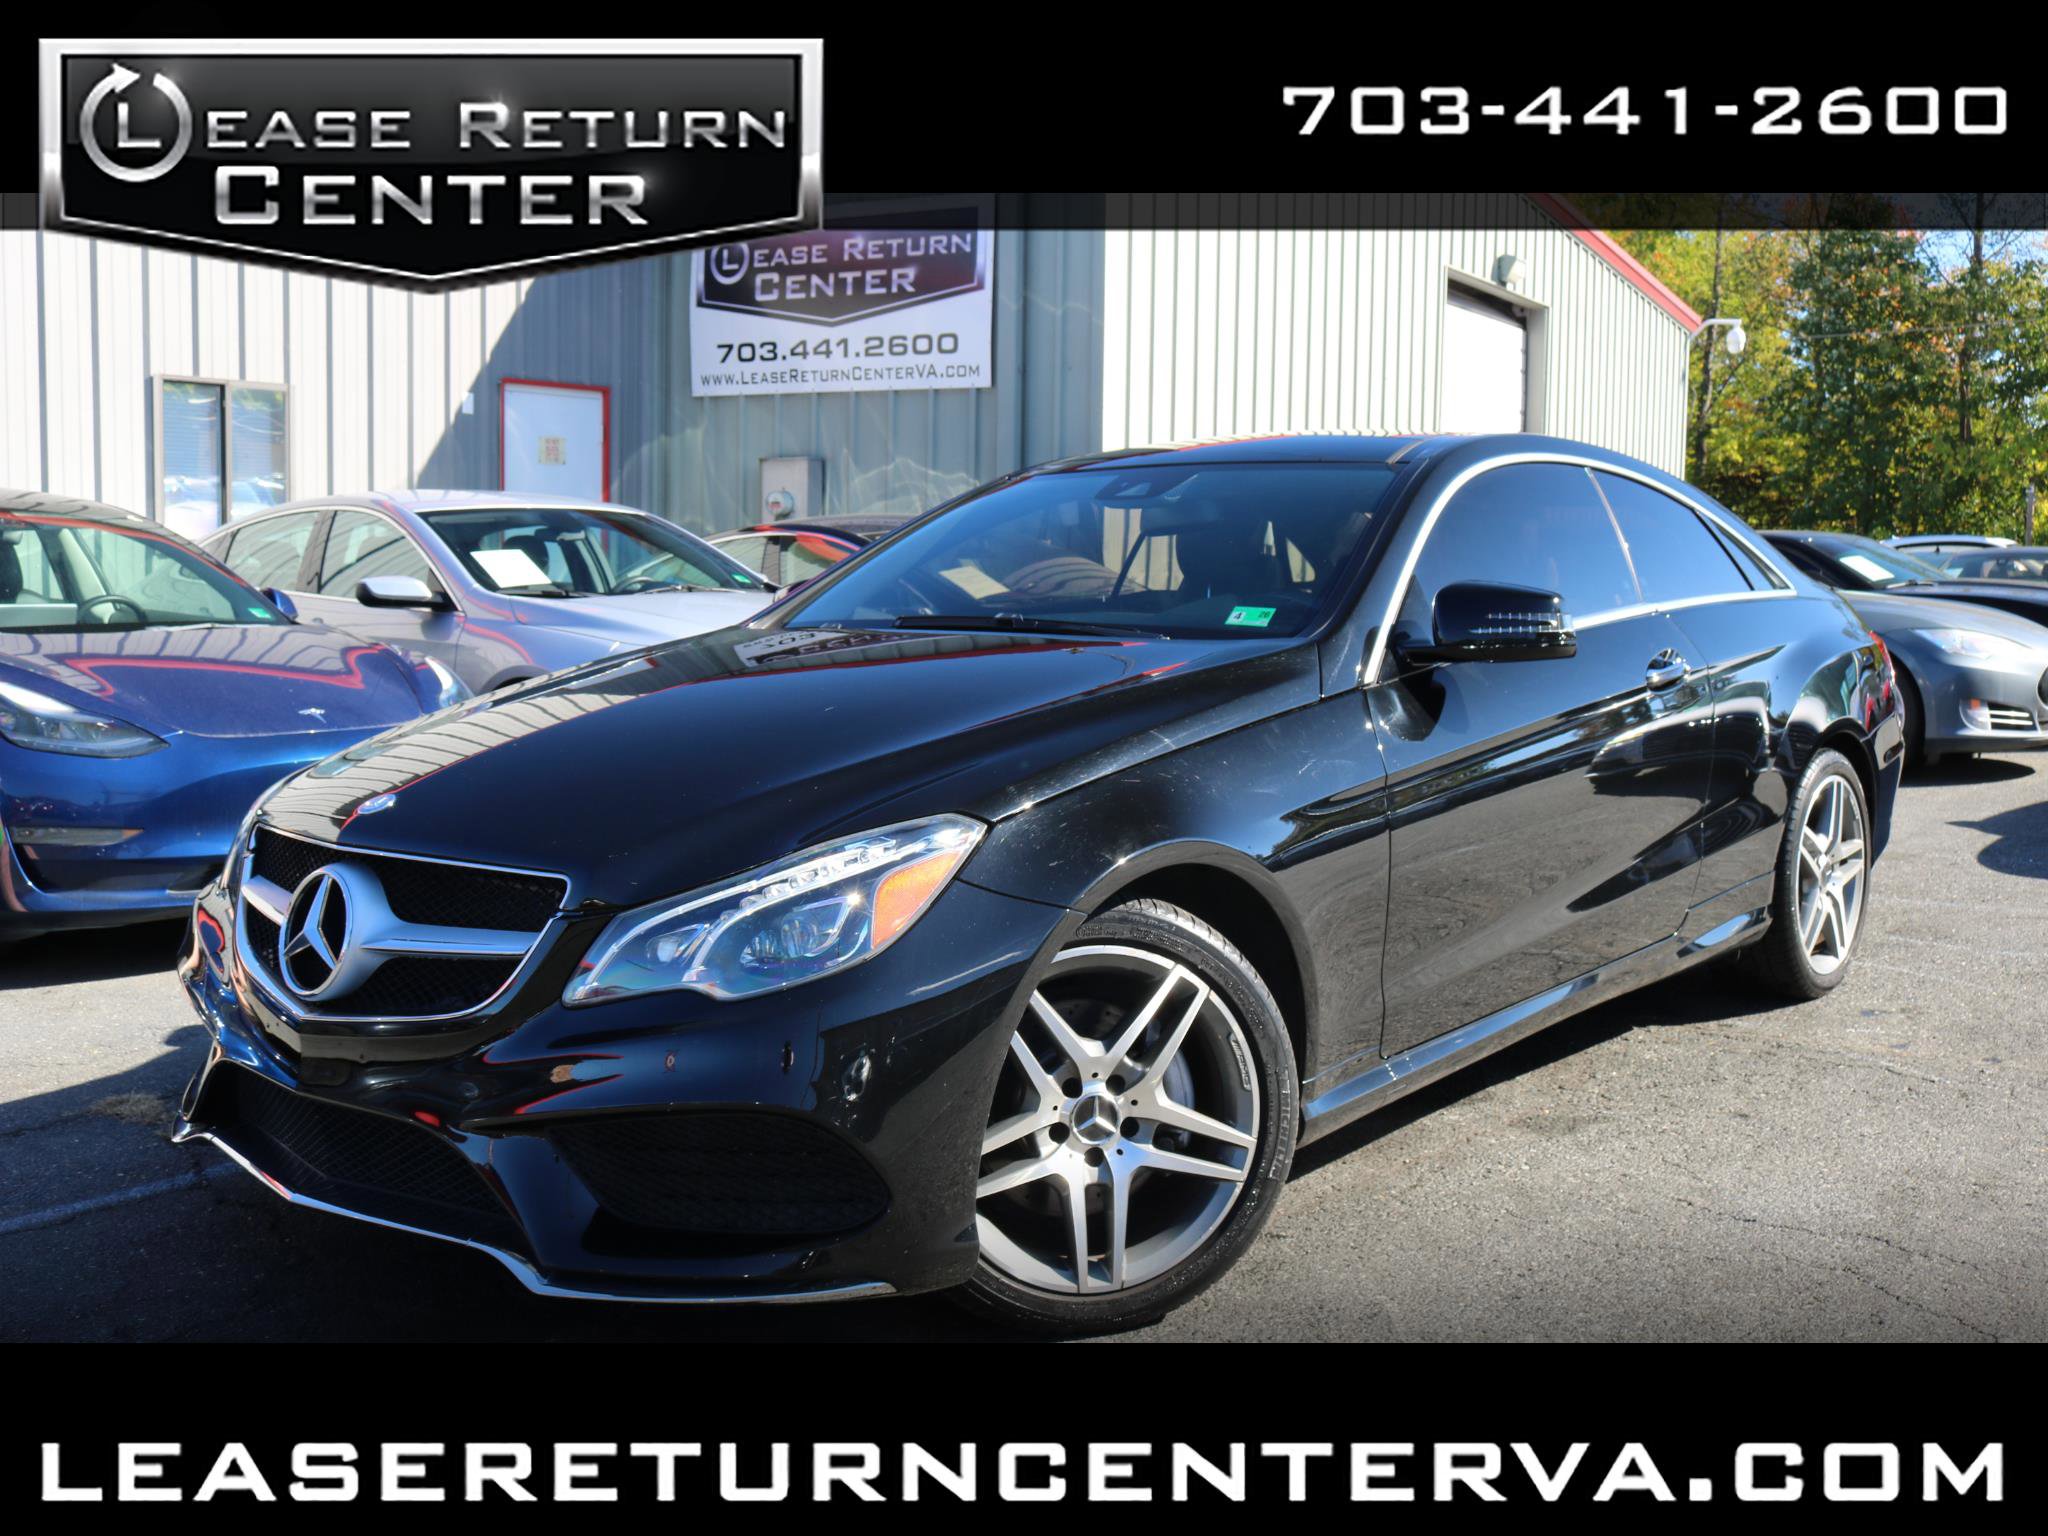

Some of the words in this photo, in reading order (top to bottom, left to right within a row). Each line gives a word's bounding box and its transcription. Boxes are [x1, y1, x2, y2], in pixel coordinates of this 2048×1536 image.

[721, 244, 828, 270] LEASE
[843, 233, 972, 261] RETURN
[754, 267, 916, 301] CENTER
[716, 333, 959, 364] 703.441.2600
